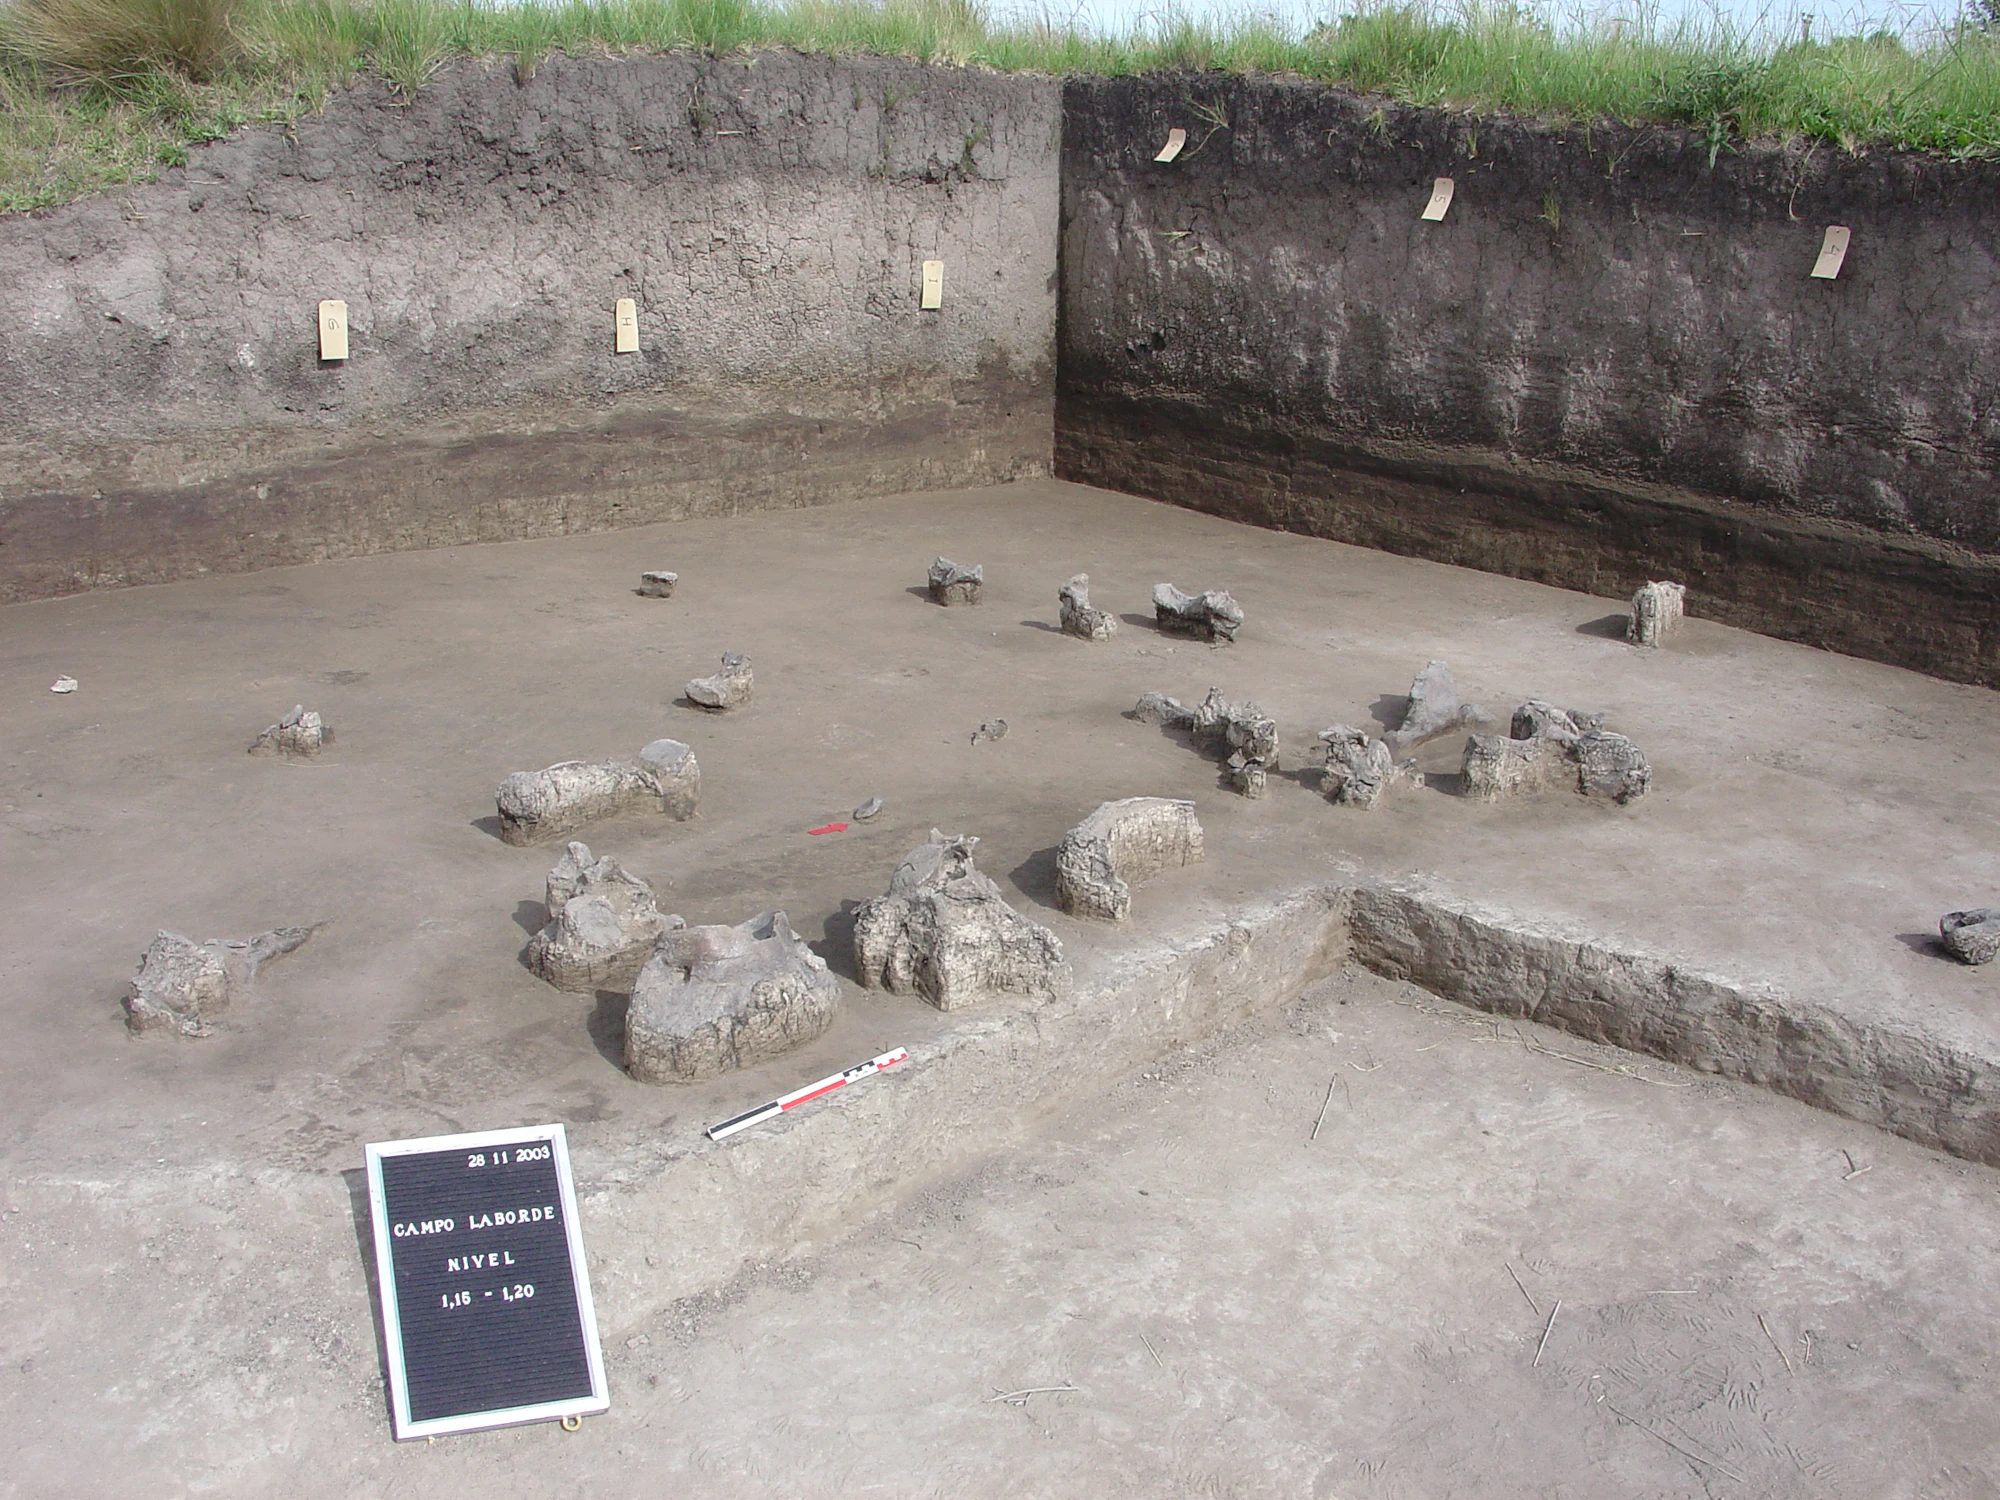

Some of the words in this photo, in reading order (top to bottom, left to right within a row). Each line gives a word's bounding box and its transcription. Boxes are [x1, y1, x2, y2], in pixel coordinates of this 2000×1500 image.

[1434, 194, 1446, 203] 5
[1822, 245, 1840, 255] 4
[621, 316, 632, 326] H
[467, 1153, 486, 1168] 28
[493, 1151, 508, 1165] 11
[516, 1145, 550, 1162] 2003
[393, 1218, 455, 1237] CAMPO
[468, 1206, 555, 1230] LABORDE
[447, 1251, 515, 1272] NIVEL
[441, 1290, 472, 1310] 1,15
[502, 1284, 535, 1302] 1,20
